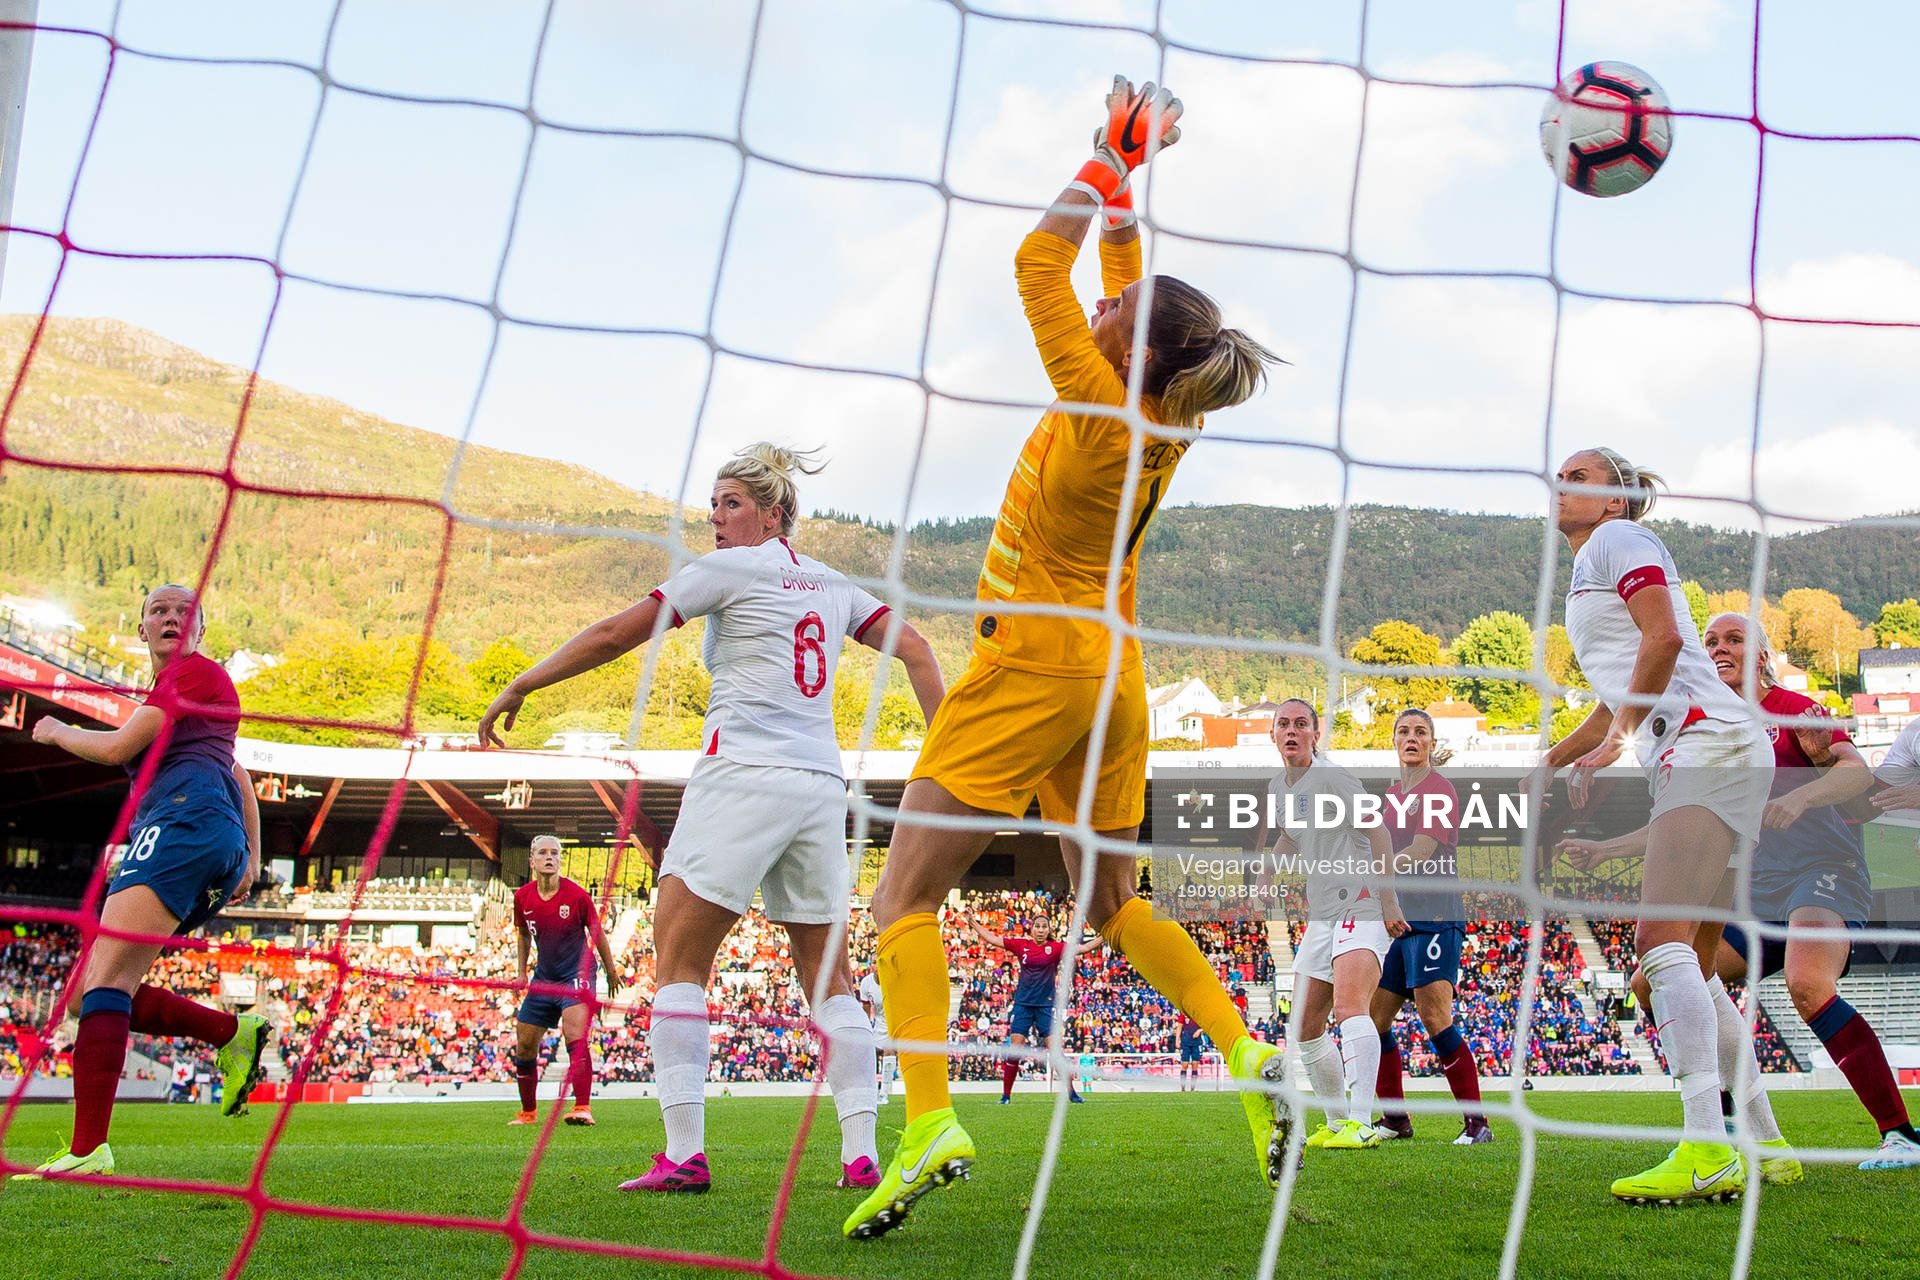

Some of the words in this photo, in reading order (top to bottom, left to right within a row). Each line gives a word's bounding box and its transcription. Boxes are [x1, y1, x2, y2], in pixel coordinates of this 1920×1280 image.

[779, 566, 827, 593] BRIGHT
[793, 610, 827, 699] 6
[1197, 759, 1223, 770] BOB
[127, 825, 161, 862] 18
[526, 920, 537, 936] 15
[1341, 909, 1356, 934] 4
[1426, 933, 1442, 961] 6
